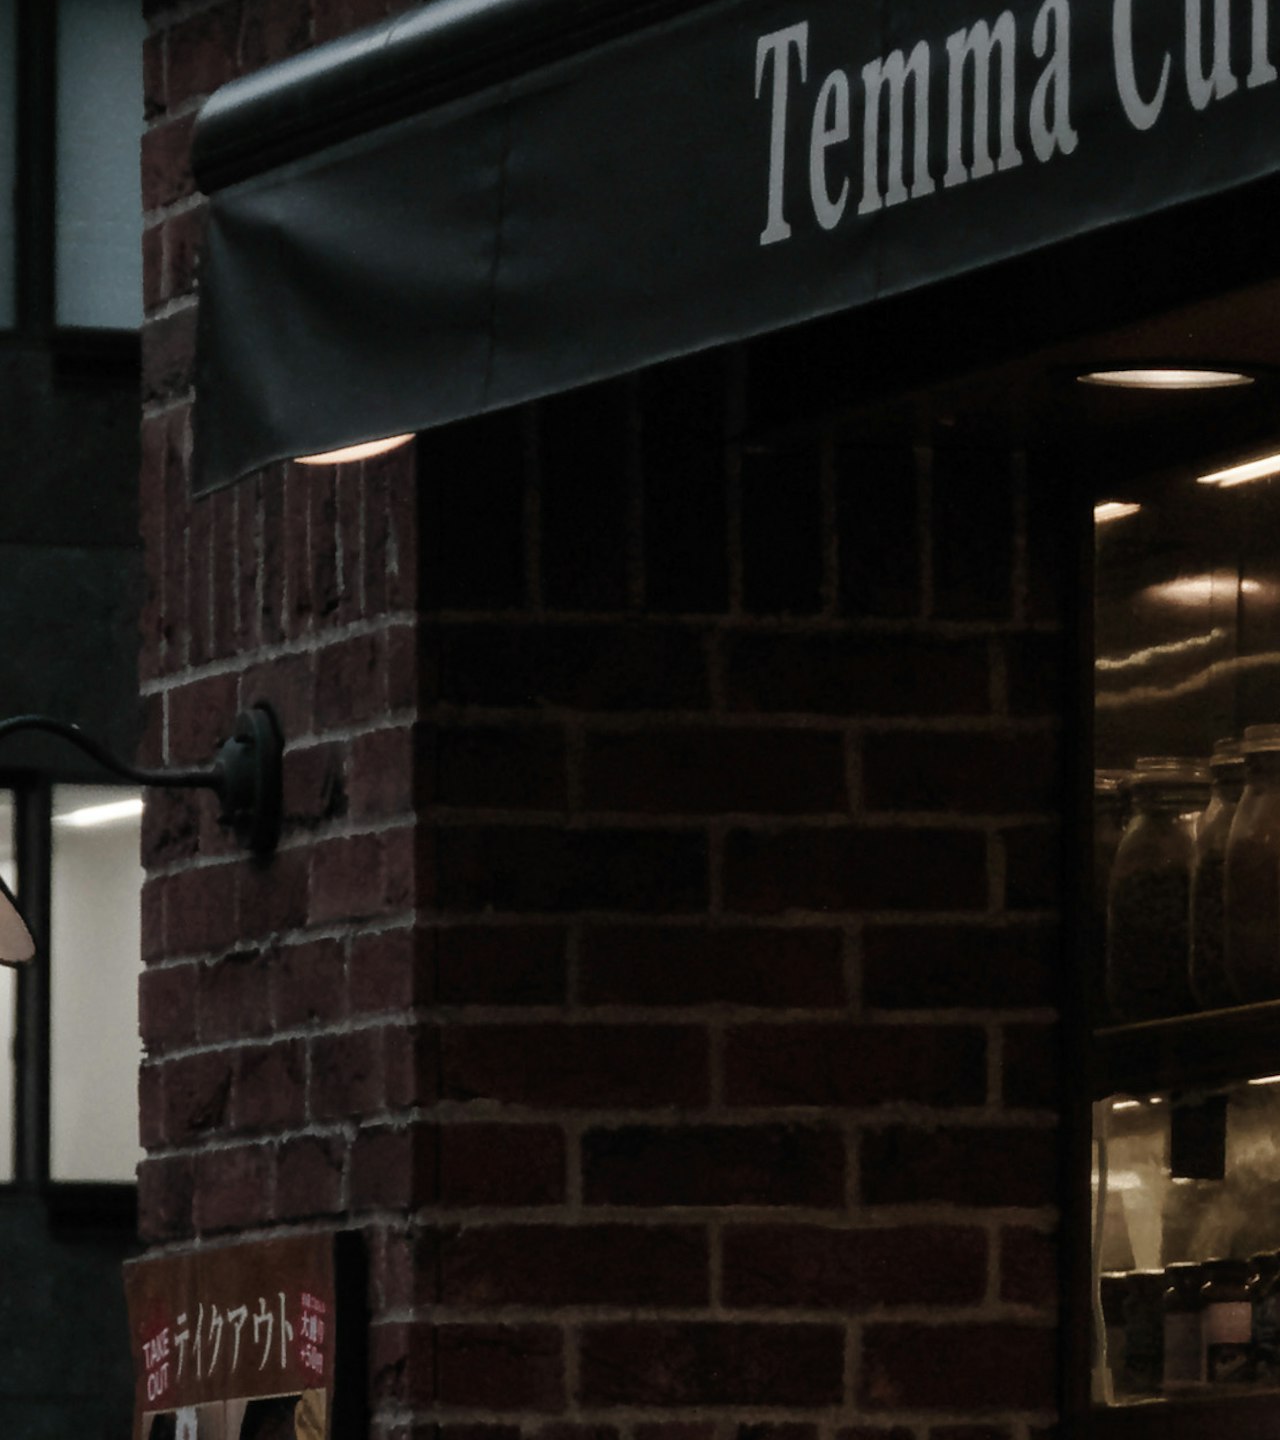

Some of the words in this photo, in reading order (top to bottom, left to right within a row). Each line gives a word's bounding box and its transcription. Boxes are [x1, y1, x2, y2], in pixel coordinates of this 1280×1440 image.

[141, 1326, 171, 1370] TAKE
[173, 1291, 294, 1382] テイクアウト
[146, 1361, 171, 1402] OUT
